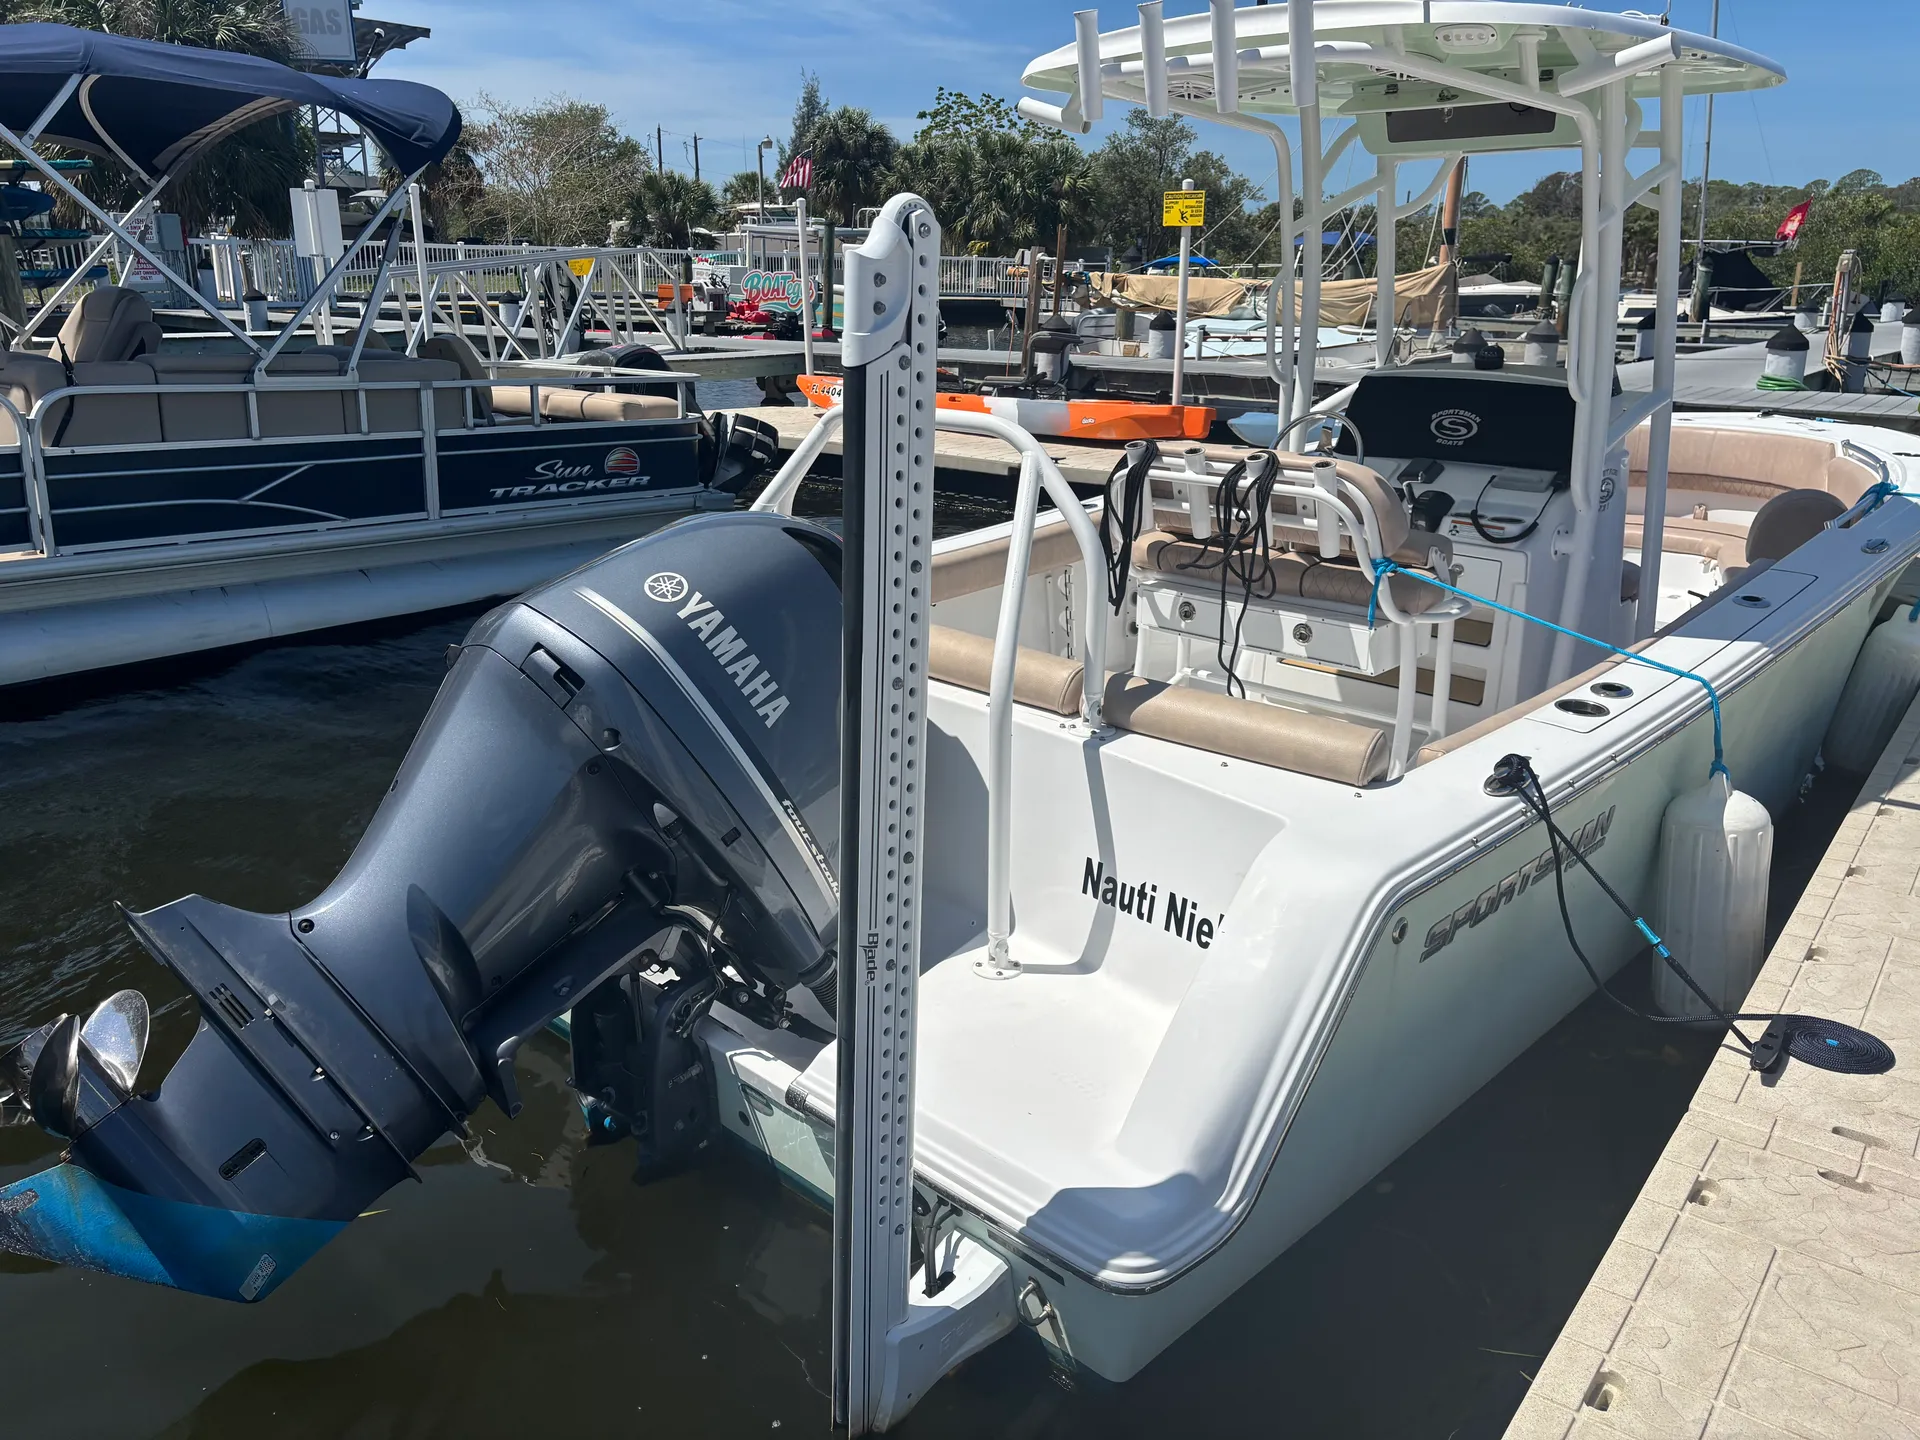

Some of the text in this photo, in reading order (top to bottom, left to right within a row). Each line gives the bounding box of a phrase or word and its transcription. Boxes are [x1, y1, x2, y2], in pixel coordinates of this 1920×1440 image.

[292, 7, 342, 35] GAS
[743, 271, 814, 305] BOATeg
[811, 384, 842, 398] FL 4404
[1431, 408, 1482, 423] SPORTSMAN
[1436, 438, 1465, 446] BOATS
[525, 460, 593, 481] Sun
[489, 475, 651, 499] TRACKER
[676, 591, 791, 729] YAMAHA
[782, 799, 840, 900] fourstrok
[1081, 856, 1158, 925] Nauti
[1419, 804, 1617, 964] SPORTSMAN
